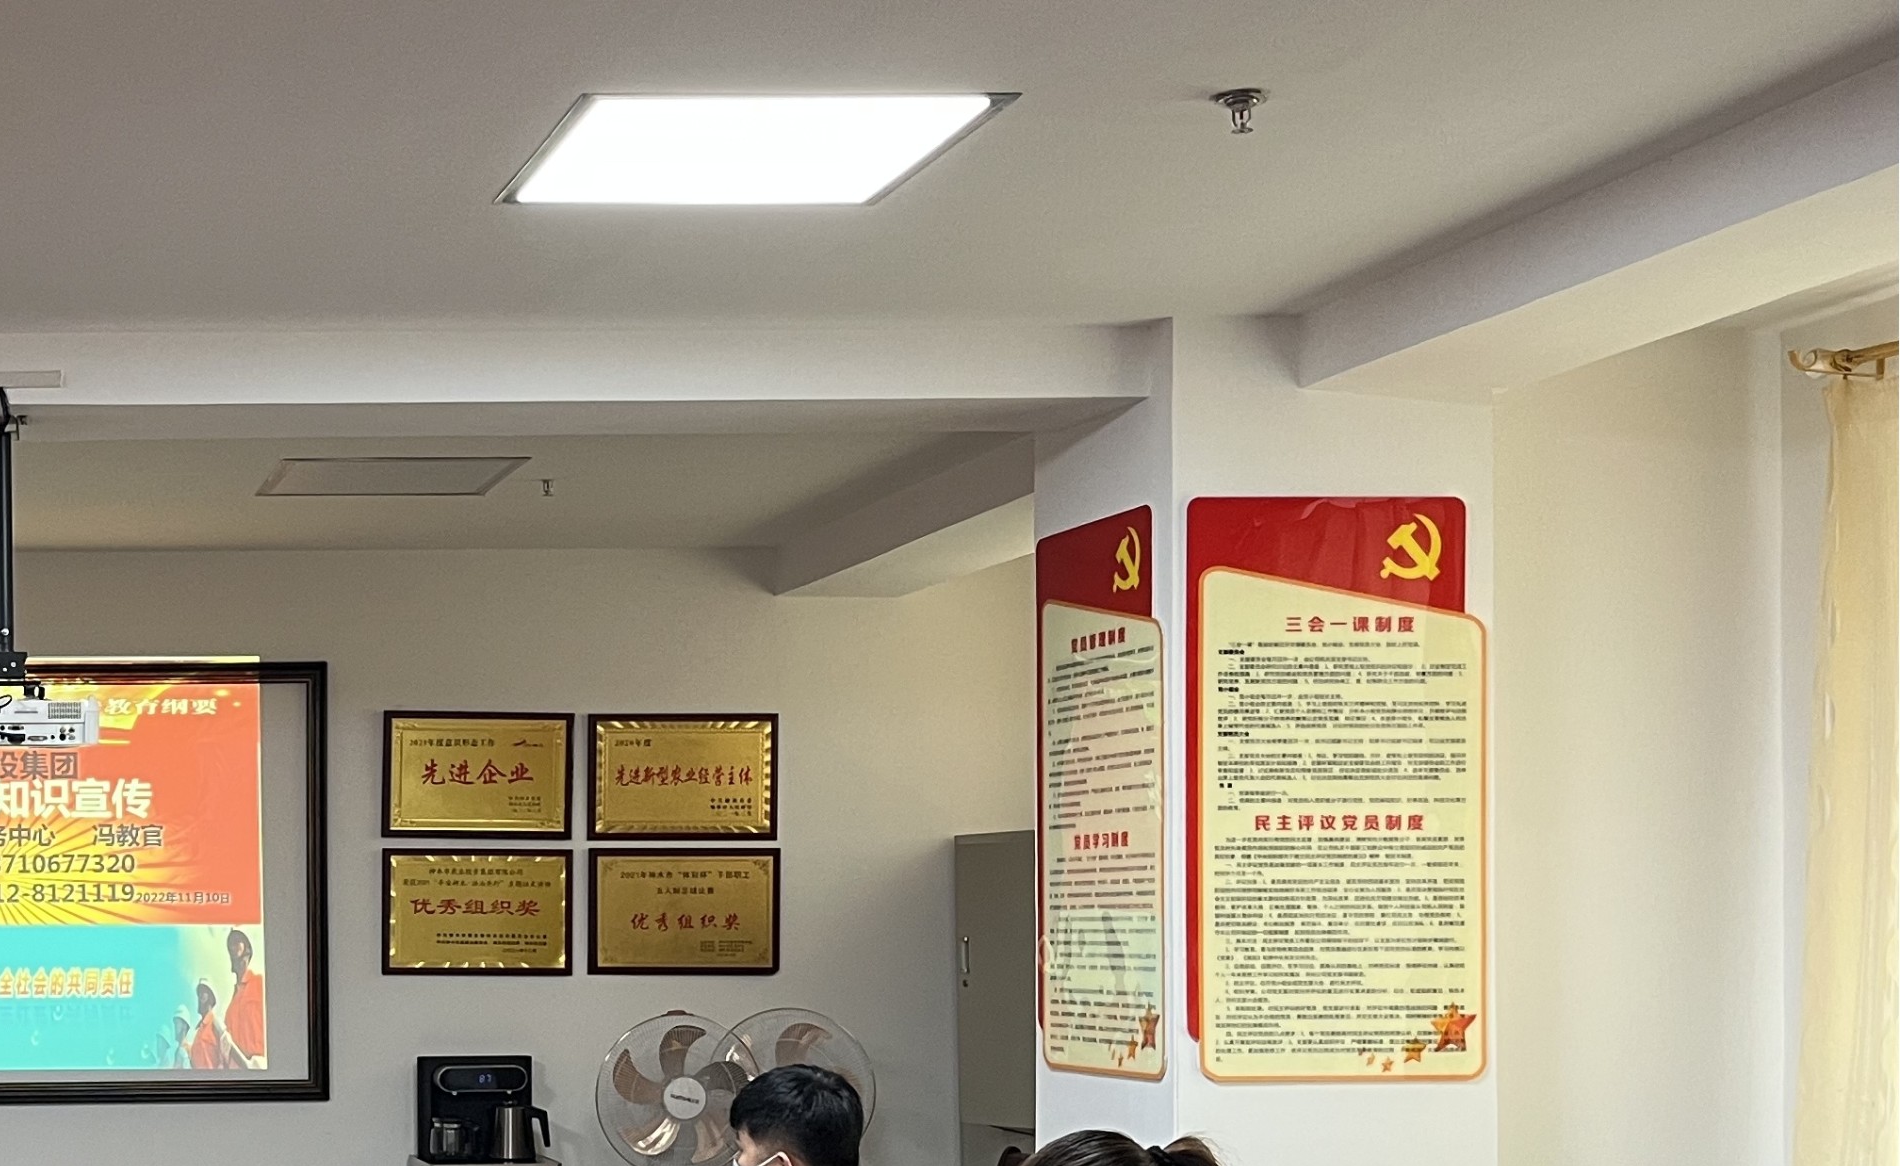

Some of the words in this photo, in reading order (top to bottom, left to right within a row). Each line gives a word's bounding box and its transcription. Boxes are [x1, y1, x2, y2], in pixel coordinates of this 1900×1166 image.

[1285, 616, 1415, 632] 三会一课制度
[421, 758, 534, 786] 先进企业
[614, 764, 753, 787] 先进新型农业经营主体
[1254, 815, 1425, 832] 民主评议党员制度
[91, 824, 164, 848] 冯教官
[410, 898, 541, 917] 优秀组织奖
[630, 912, 741, 932] 优秀组织奖
